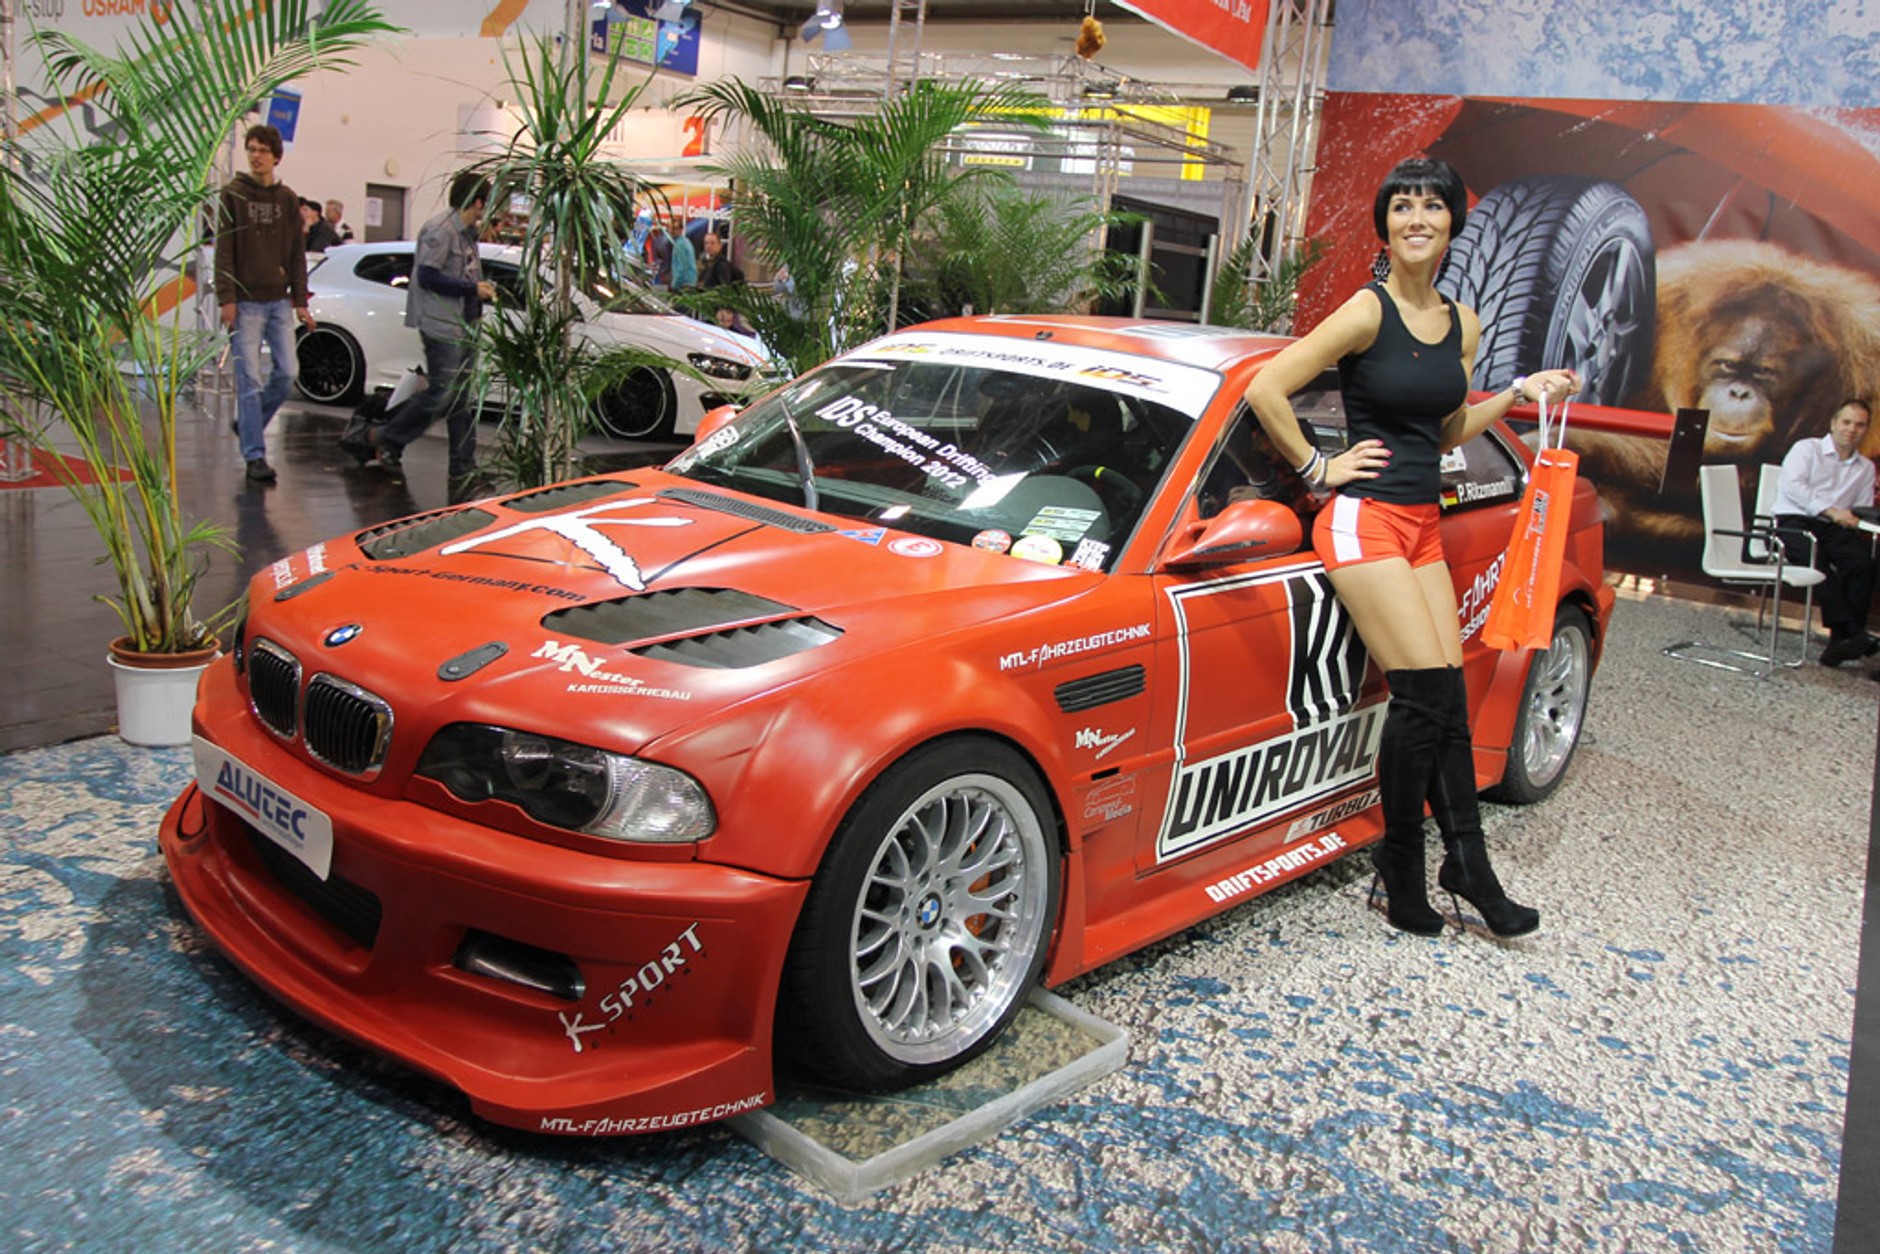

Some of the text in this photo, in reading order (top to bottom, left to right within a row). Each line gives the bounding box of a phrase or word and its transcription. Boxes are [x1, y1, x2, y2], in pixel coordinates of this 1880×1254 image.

[82, 0, 145, 17] OSRAM
[815, 395, 999, 487] IDS European Drifting
[854, 423, 968, 490] Champion 2012
[1000, 623, 1151, 670] MTL-FAHRZEUGTECHNIK
[216, 760, 308, 841] ALUTEC
[1167, 711, 1378, 841] UNIROYAL
[1205, 832, 1347, 903] DRIFTSPORTS.DE
[598, 921, 703, 1023] SPORT
[541, 1092, 767, 1137] MTL-FAHRZEUGTECHNIK
